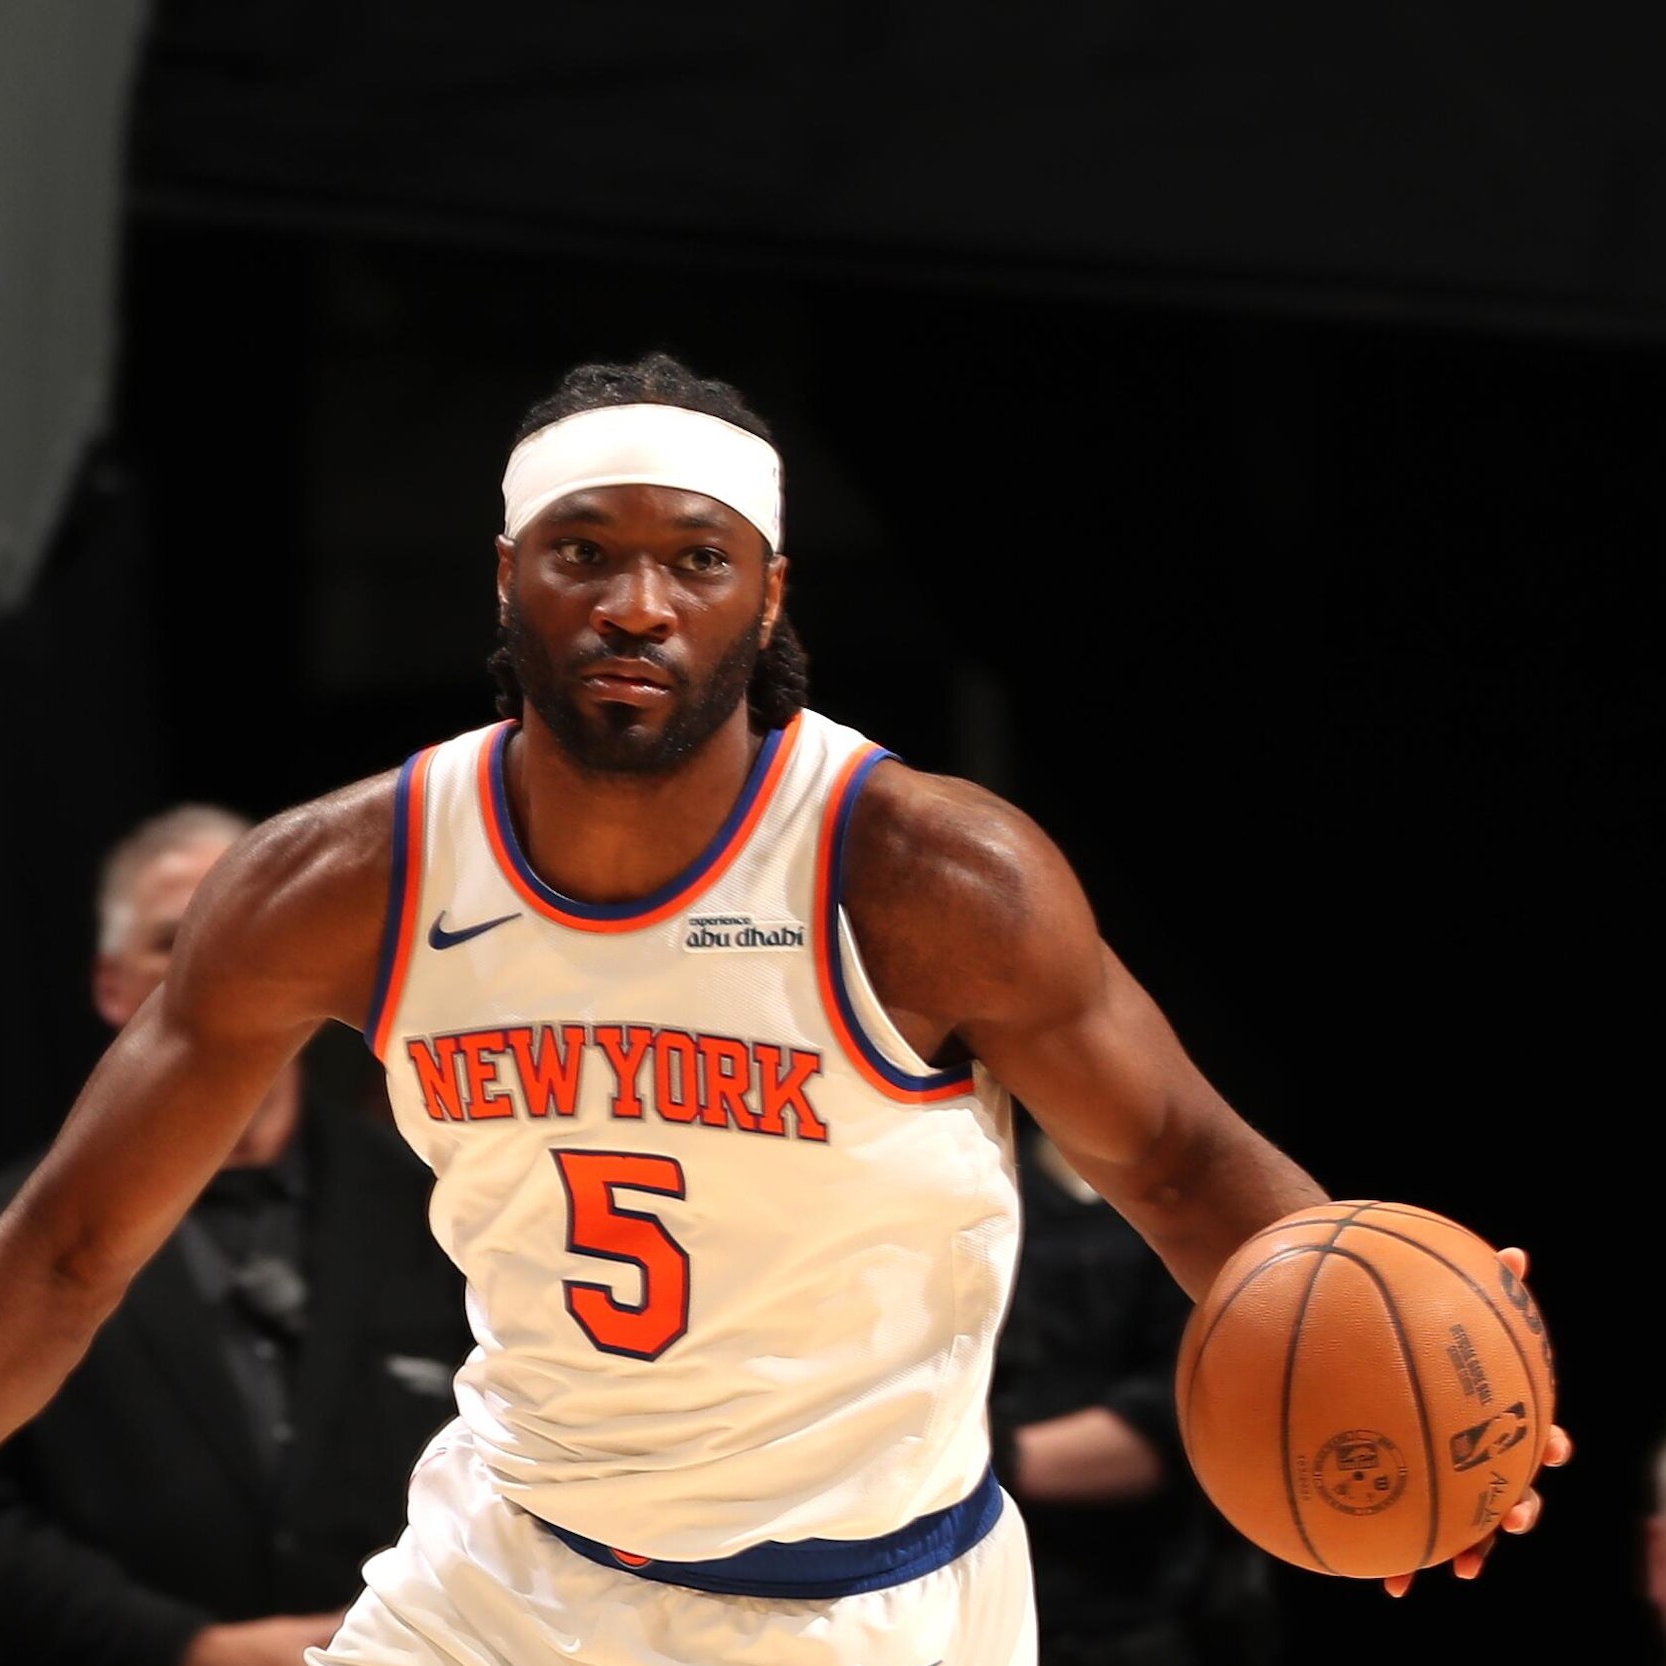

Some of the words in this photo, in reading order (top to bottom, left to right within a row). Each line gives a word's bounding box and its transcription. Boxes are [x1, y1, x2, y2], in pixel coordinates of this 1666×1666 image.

[686, 928, 730, 947] abu
[735, 926, 805, 947] dhabi
[689, 915, 751, 927] experience
[406, 1022, 587, 1122] NEW
[594, 1023, 831, 1144] YORK
[548, 1147, 691, 1362] 5
